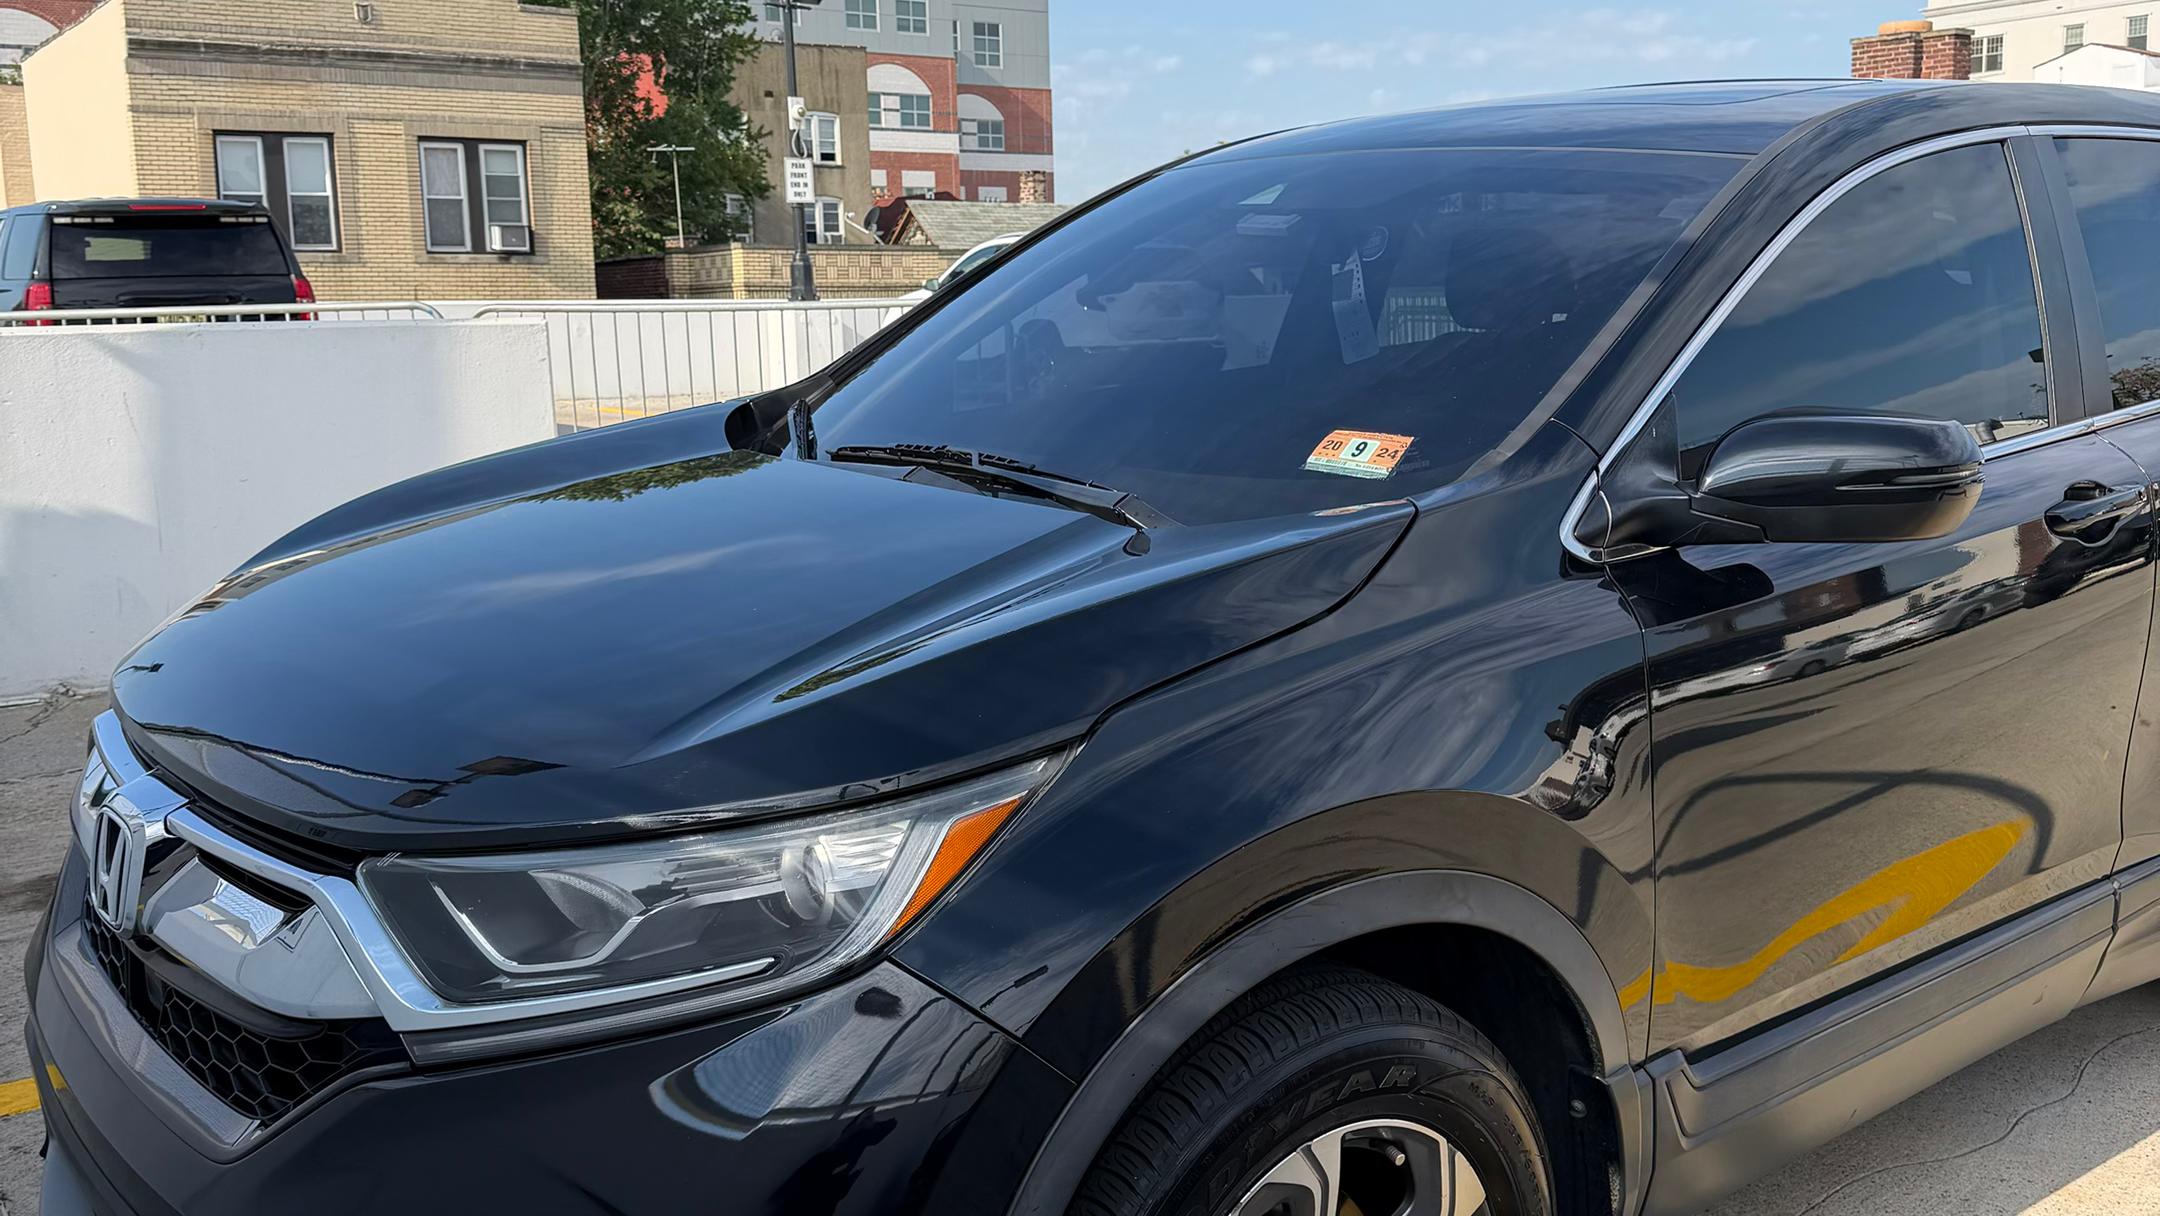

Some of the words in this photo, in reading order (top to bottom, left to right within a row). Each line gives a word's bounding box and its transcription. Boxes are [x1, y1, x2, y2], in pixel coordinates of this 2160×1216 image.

[1322, 439, 1344, 451] 20
[1350, 441, 1368, 458] 9
[1375, 447, 1400, 460] 24
